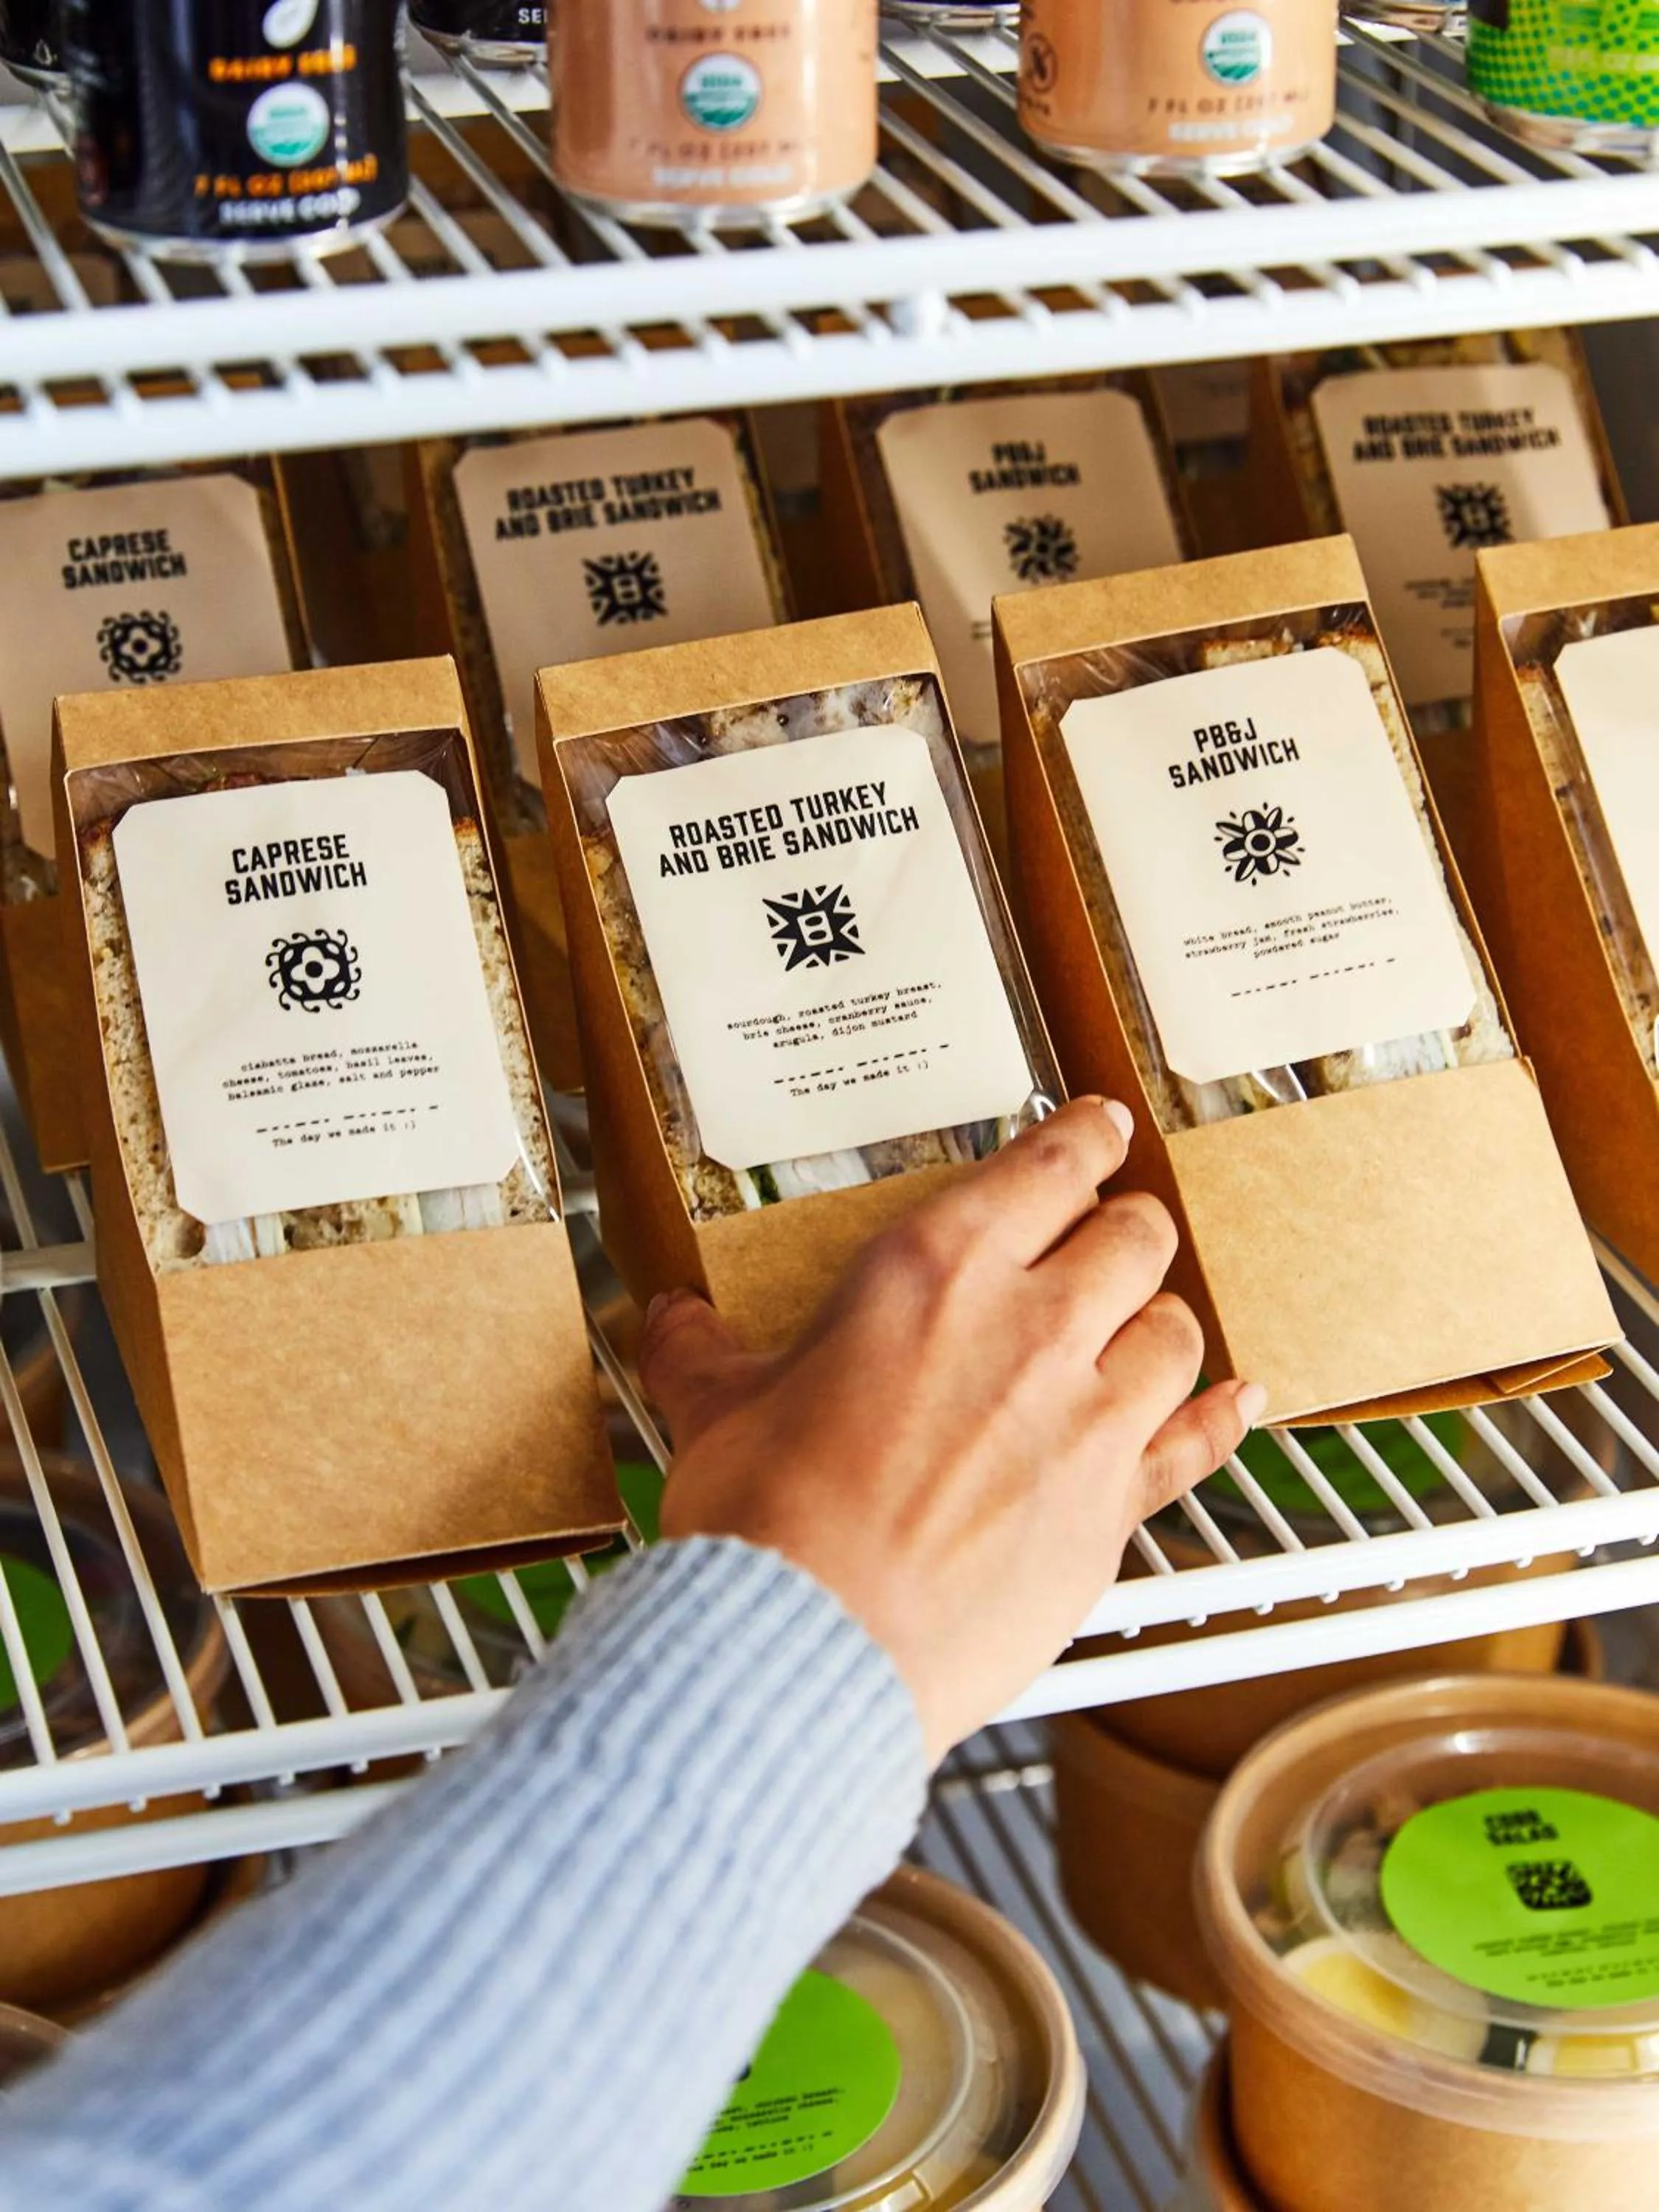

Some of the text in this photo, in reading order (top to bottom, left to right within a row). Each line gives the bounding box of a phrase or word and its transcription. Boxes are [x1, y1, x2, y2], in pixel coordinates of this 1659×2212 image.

[1362, 407, 1535, 437] ROASTED TURKEY
[1352, 435, 1396, 462] AND
[1452, 428, 1562, 458] SANDWICH
[506, 466, 695, 512] ROASTED TURKEY
[968, 464, 1082, 495] SANDWICH
[495, 488, 723, 541] AND BRIE SANDWICH
[67, 528, 171, 563] CAPRESE
[61, 552, 188, 590] SANDWICH
[1192, 717, 1258, 754] PB&J
[1168, 737, 1301, 788] SANDWICH
[669, 781, 887, 849] ROASTED TURKEY
[232, 833, 350, 874] CAPRESE
[659, 805, 920, 878] AND BRIE SANDWICH
[224, 860, 368, 906] SANDWICH
[1183, 897, 1393, 947] white bread, smooth peanut butter,
[1185, 908, 1399, 959] strawberry jam, fresh strawberries,
[1253, 932, 1340, 959] powdered sugar
[726, 981, 942, 1031] sourdough, roasted turkey breast,
[742, 996, 933, 1041] brie cheese, cranberry sauce,
[772, 1010, 919, 1048] arugula, dijon mustard
[222, 1053, 434, 1089] cheese, tomatoes, basil leaves,
[240, 1040, 418, 1072] ciabatta bread, mozzarella
[228, 1065, 441, 1102] balsamic glaze, salt and pepper
[790, 1086, 811, 1098] The
[816, 1081, 838, 1094] day
[843, 1077, 858, 1087] we
[863, 1070, 891, 1082] made
[897, 1065, 911, 1074] it
[272, 1137, 293, 1148] The
[299, 1133, 321, 1144] day
[327, 1130, 342, 1139] we
[348, 1124, 376, 1136] made
[383, 1121, 397, 1133] it
